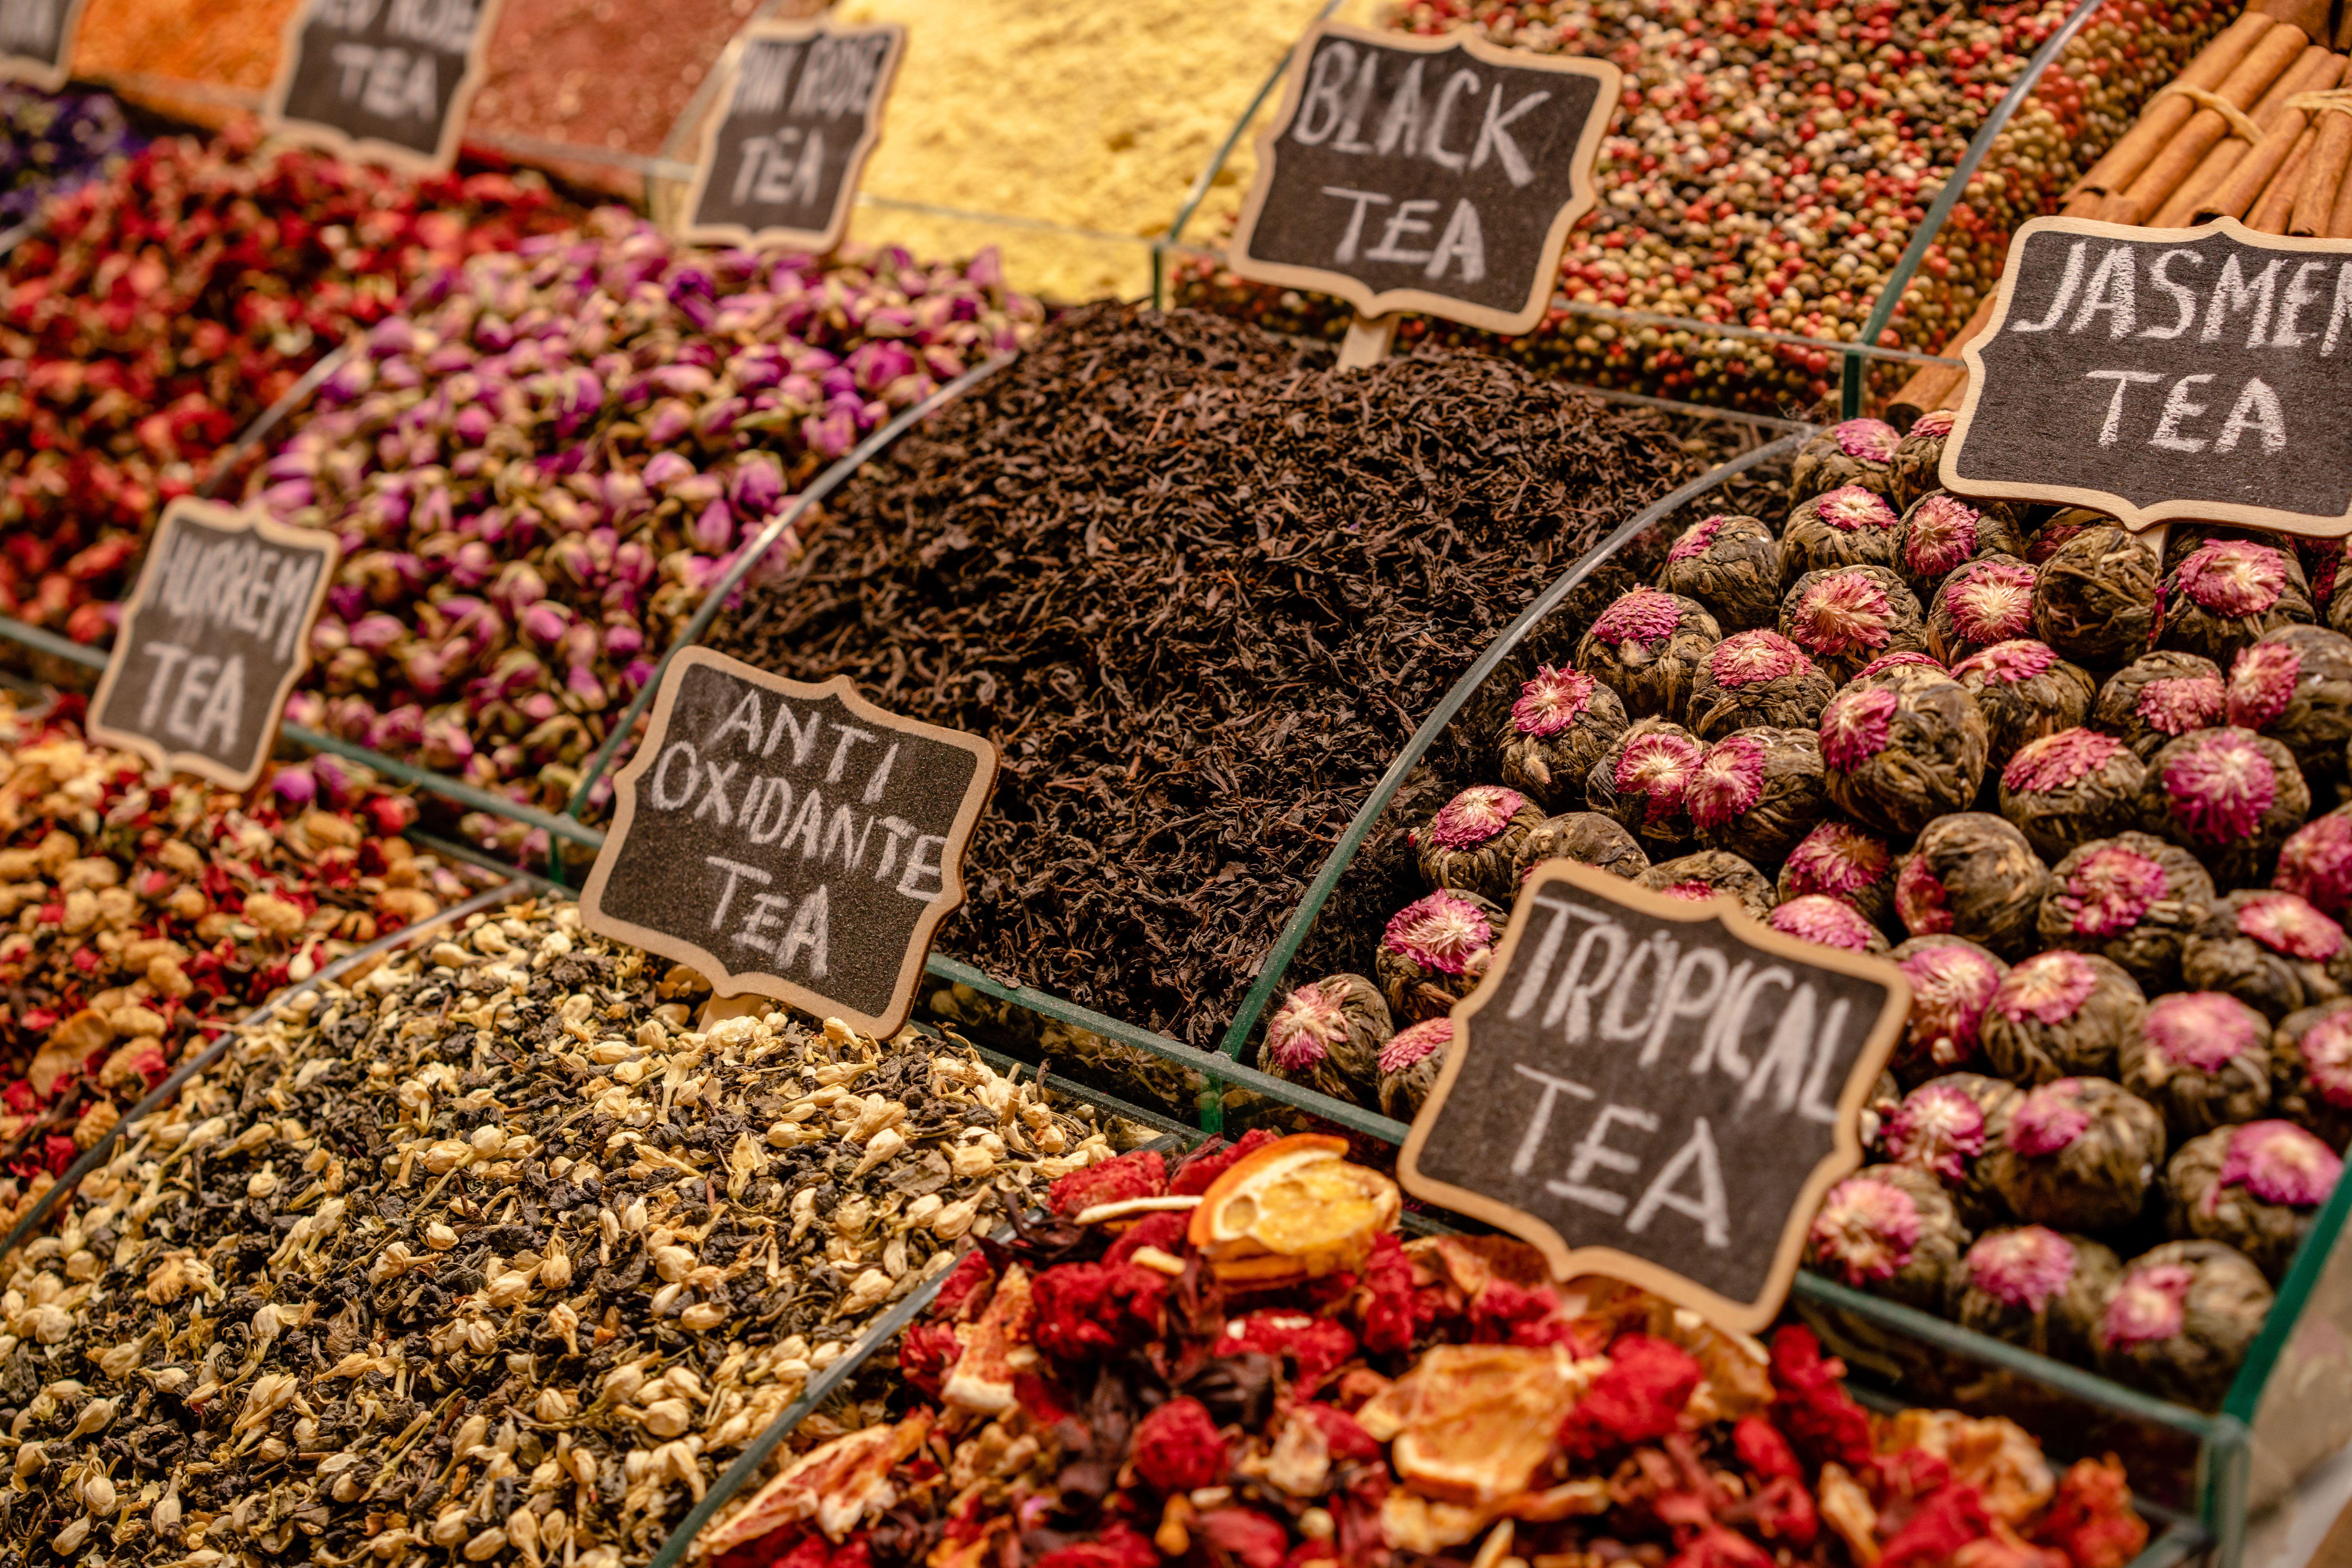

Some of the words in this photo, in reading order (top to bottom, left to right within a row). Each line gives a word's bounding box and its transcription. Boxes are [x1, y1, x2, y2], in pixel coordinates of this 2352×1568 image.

[331, 44, 438, 120] TEA
[1293, 41, 1552, 187] BLACK
[730, 127, 823, 208] TEA
[1321, 186, 1486, 283] TEA
[2085, 374, 2287, 456] TEA
[137, 641, 245, 755] TEA
[708, 688, 899, 805] ANTI
[651, 740, 947, 902] OXIDANTE
[706, 856, 830, 978] TEA
[1506, 895, 1851, 1123] TROPICAL
[1511, 1062, 1730, 1247] TEA
